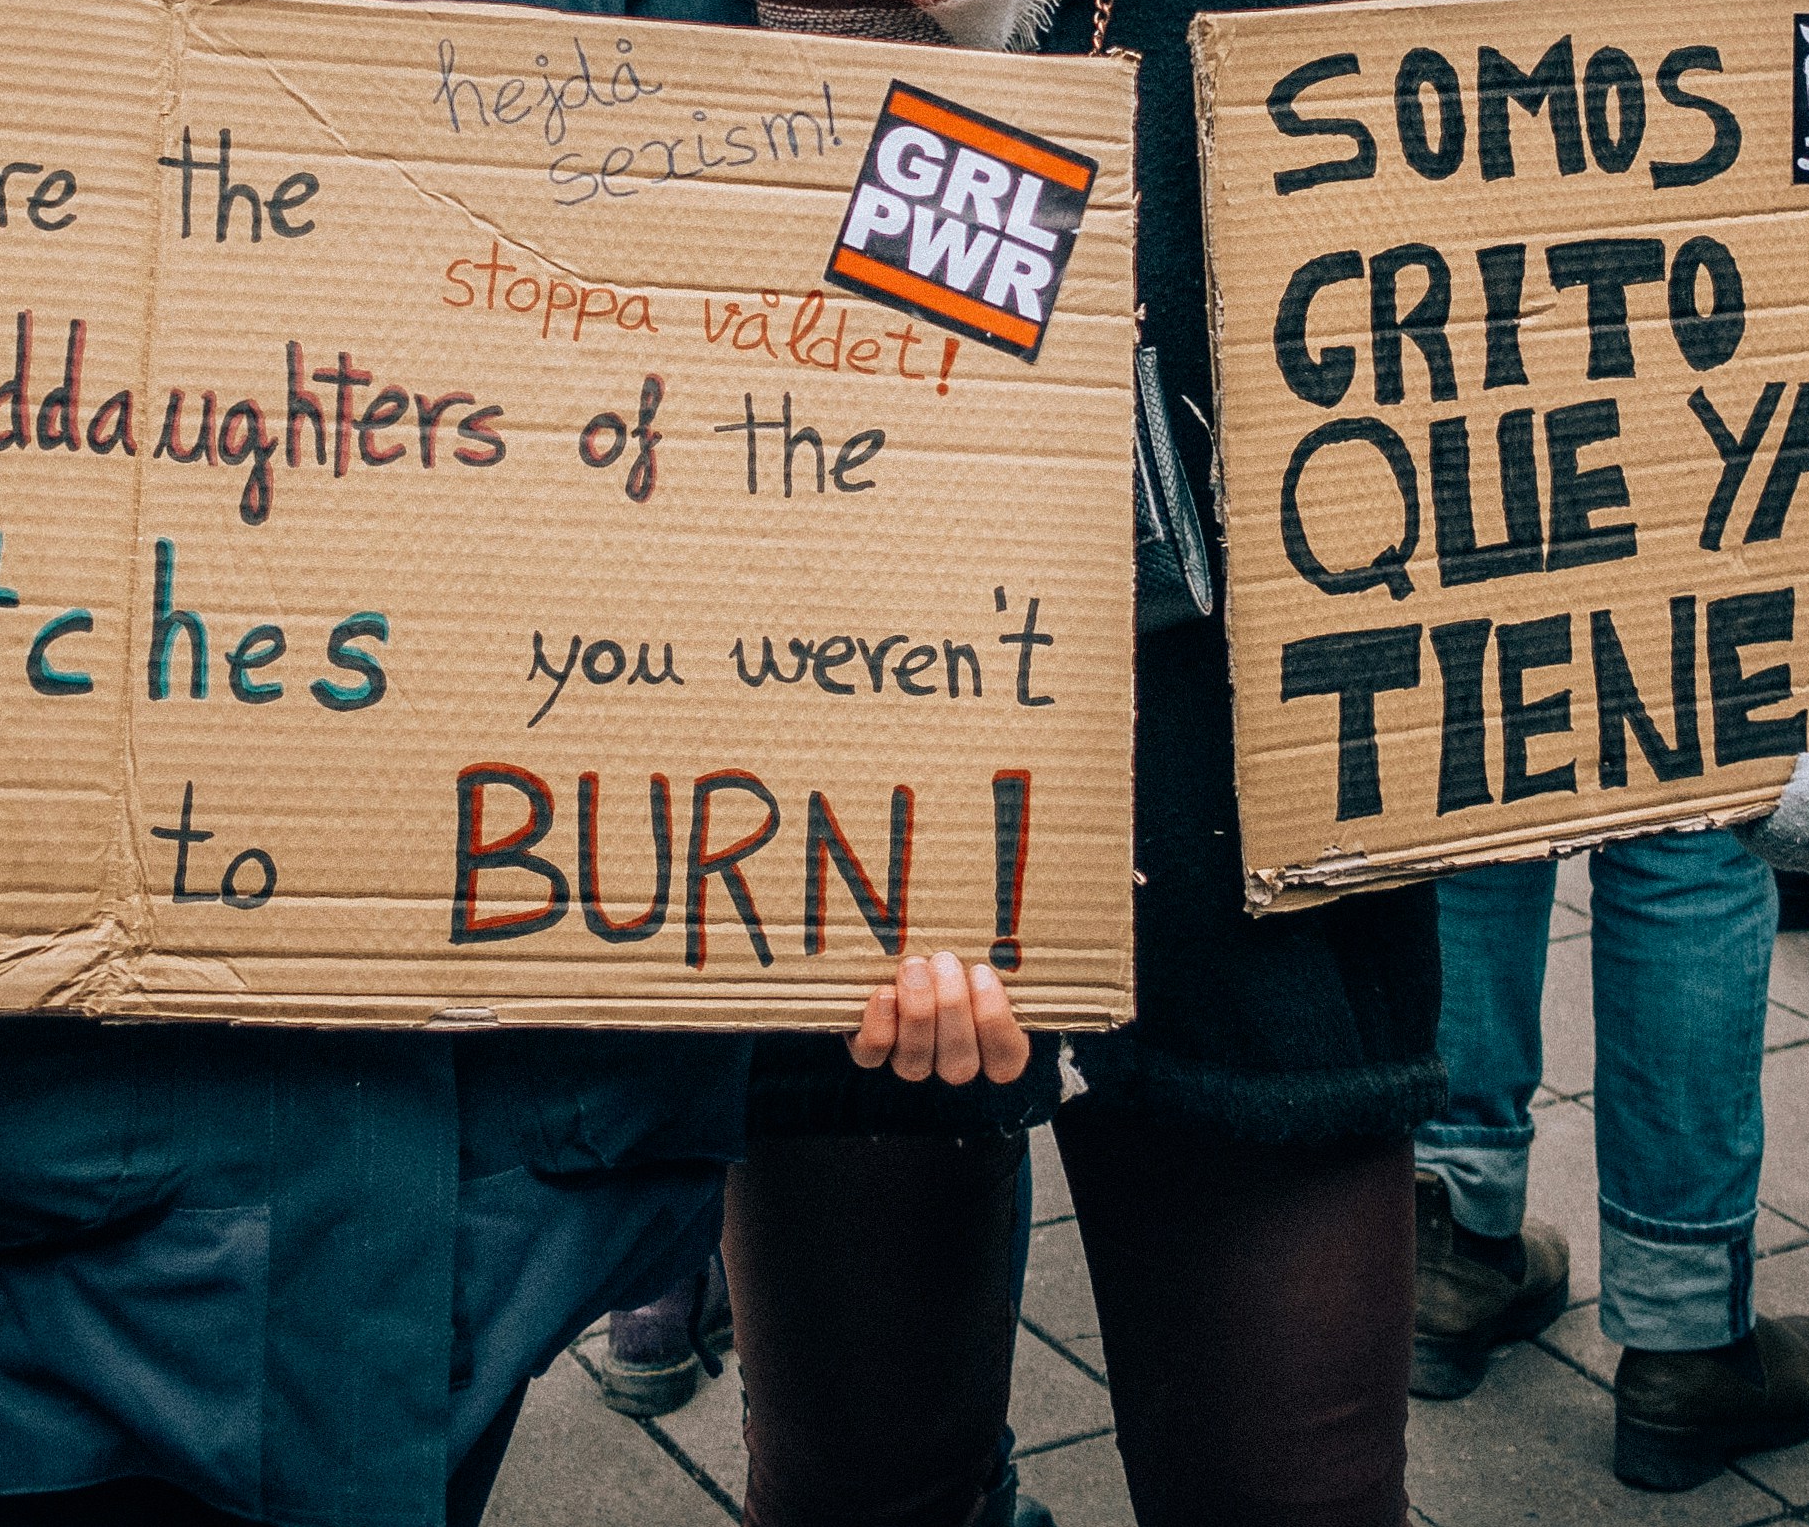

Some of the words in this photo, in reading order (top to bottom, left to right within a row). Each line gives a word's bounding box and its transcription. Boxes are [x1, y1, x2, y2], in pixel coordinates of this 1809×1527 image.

[433, 37, 662, 146] hejdå
[549, 81, 842, 205] sexism!
[1265, 34, 1742, 196] SOMOS
[159, 126, 320, 242] the
[877, 126, 1058, 252] GRL
[442, 240, 659, 342] stoppa
[704, 288, 960, 397] våldet!
[842, 183, 1054, 322] PWR
[1273, 235, 1746, 409] GRITO
[579, 374, 665, 502] of
[715, 392, 886, 498] the
[1281, 398, 1637, 600] QUE
[526, 629, 685, 728] you
[730, 586, 1056, 707] weren't
[150, 781, 278, 910] to
